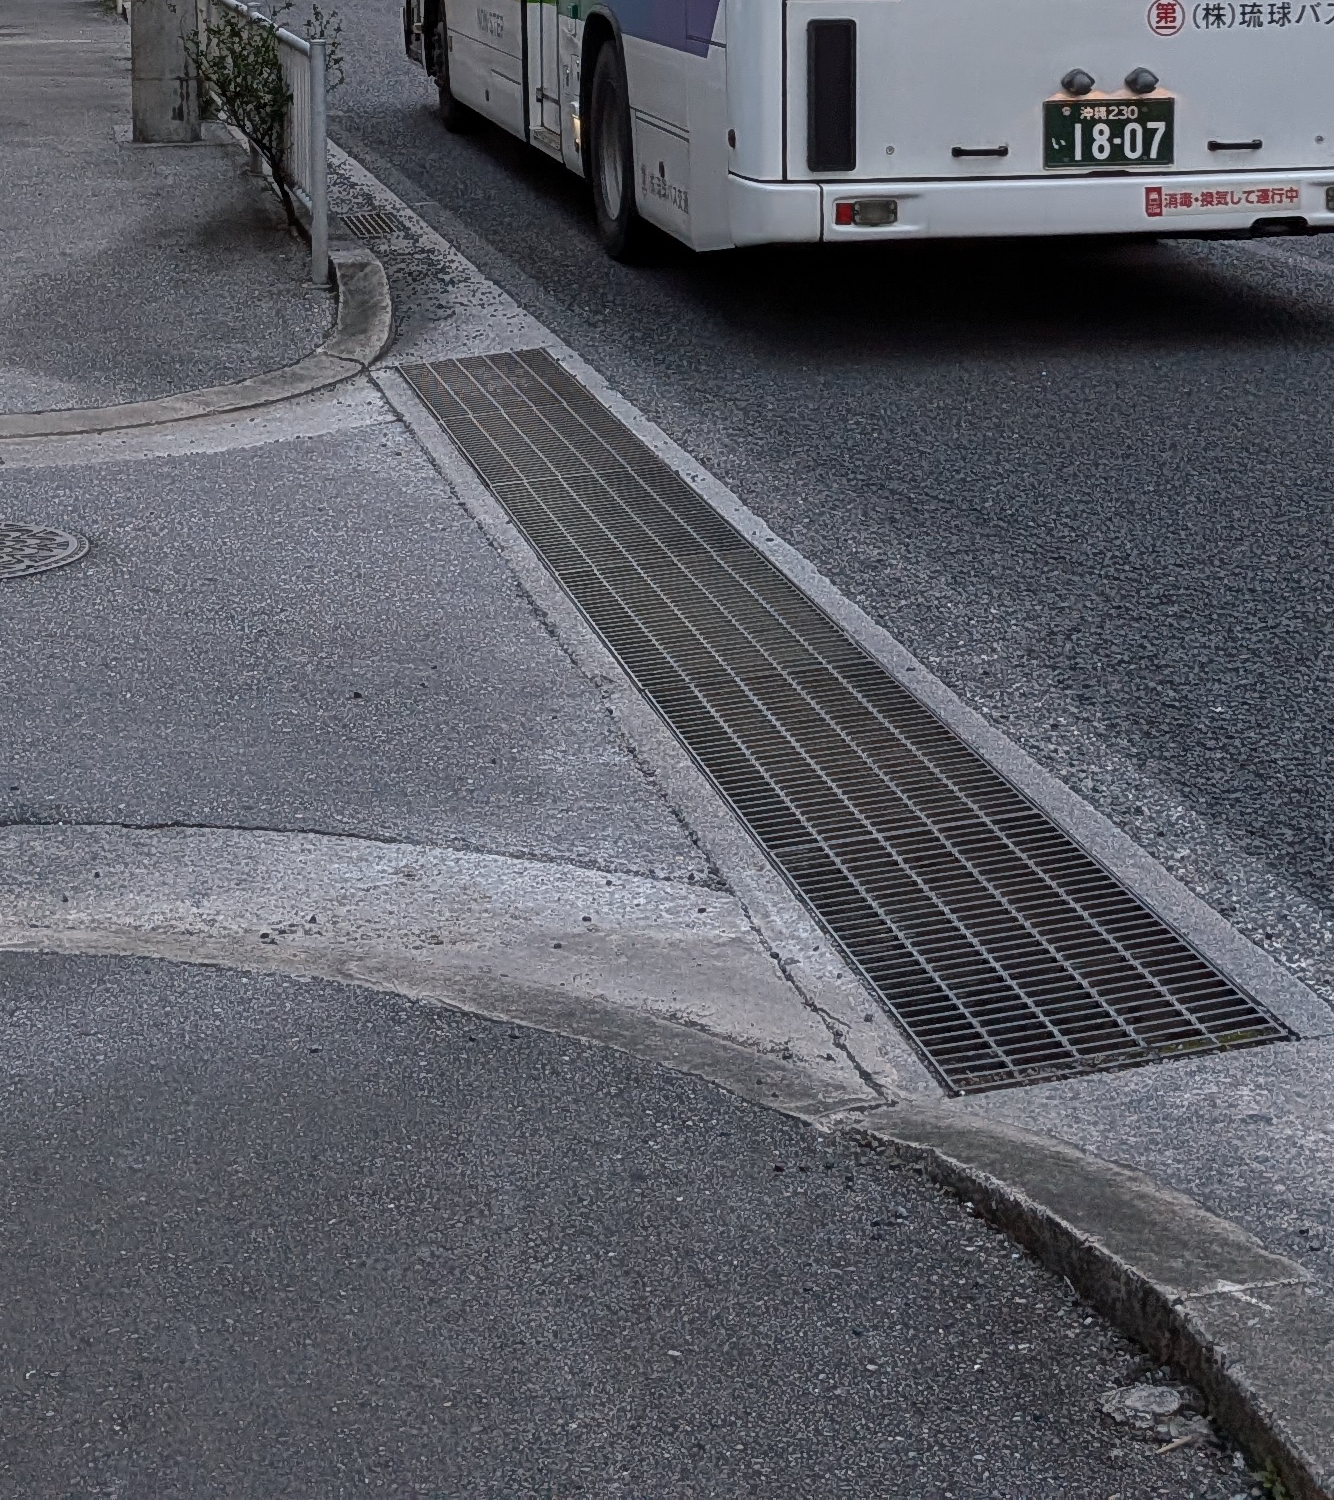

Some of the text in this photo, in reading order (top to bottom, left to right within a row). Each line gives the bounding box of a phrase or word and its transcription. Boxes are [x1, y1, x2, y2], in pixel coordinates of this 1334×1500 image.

[1074, 121, 1167, 161] 18-07
[1163, 186, 1300, 209] 消毒・換気して運行中
